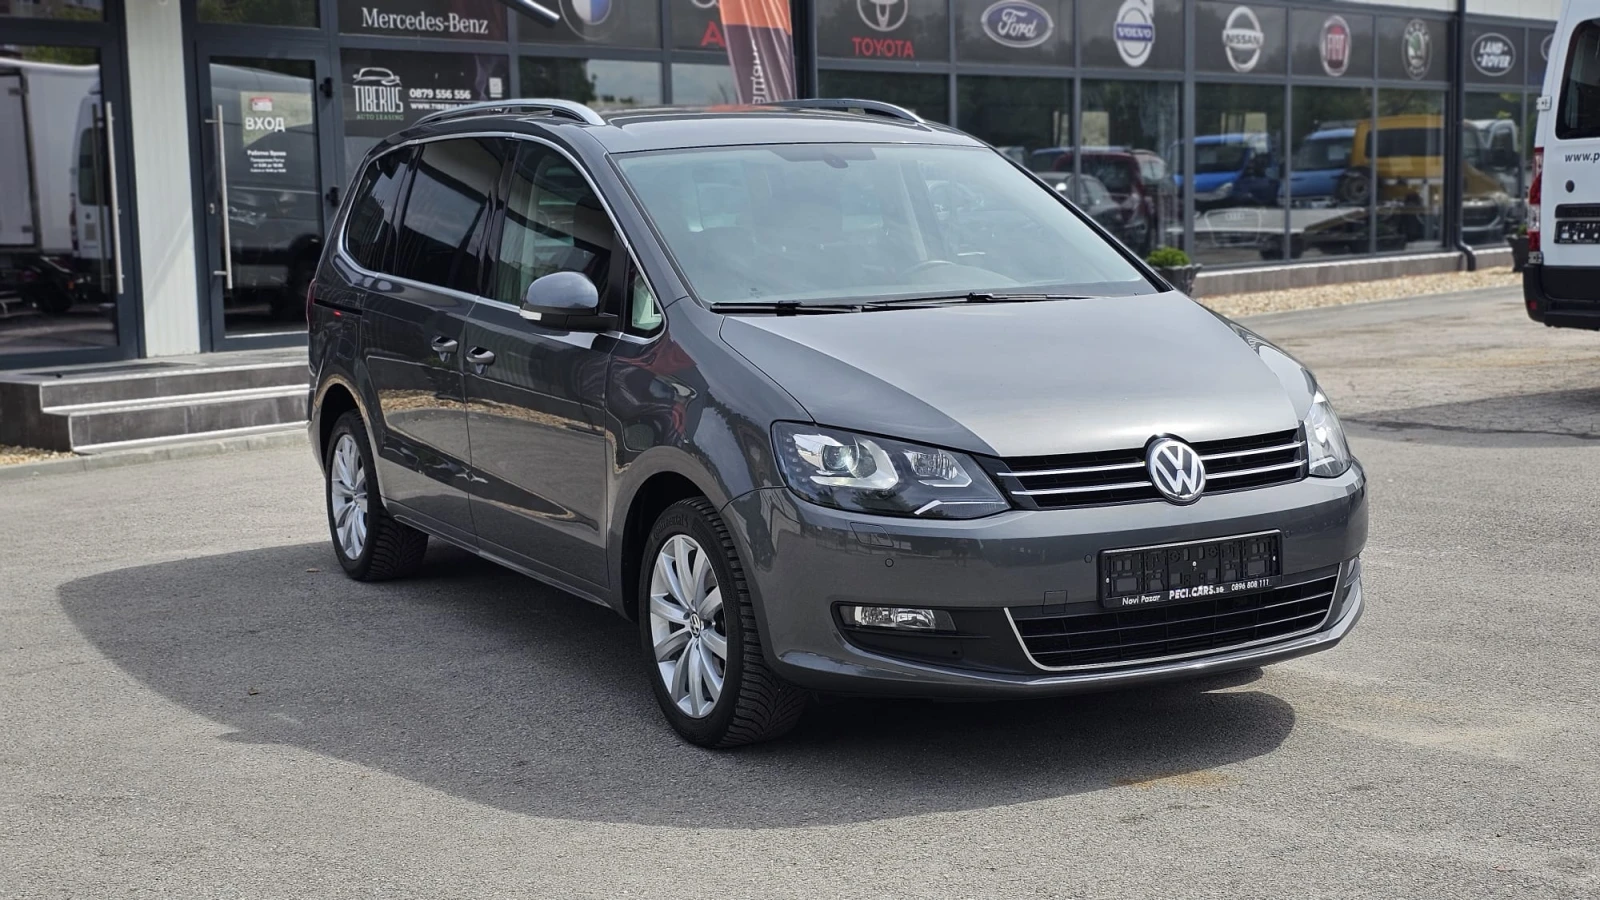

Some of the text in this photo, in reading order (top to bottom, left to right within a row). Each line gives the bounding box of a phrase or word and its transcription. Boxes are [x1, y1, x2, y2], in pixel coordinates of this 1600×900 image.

[361, 7, 489, 34] Mercedes-Benz
[998, 8, 1038, 38] Ford
[1117, 26, 1153, 39] VOLVO
[1225, 32, 1259, 45] NISSAN
[852, 37, 915, 58] TOYOTA
[1480, 41, 1504, 54] LAND
[1481, 54, 1511, 68] ROVER
[353, 85, 404, 113] TIBERUS
[409, 88, 471, 100] 0879 556 556
[245, 117, 286, 132] ВХОД
[1564, 152, 1600, 164] www.p
[1122, 595, 1139, 605] Novi
[1140, 594, 1160, 603] Pazar
[1231, 582, 1246, 591] 0896
[1247, 580, 1258, 589] 808
[1259, 578, 1270, 588] 111
